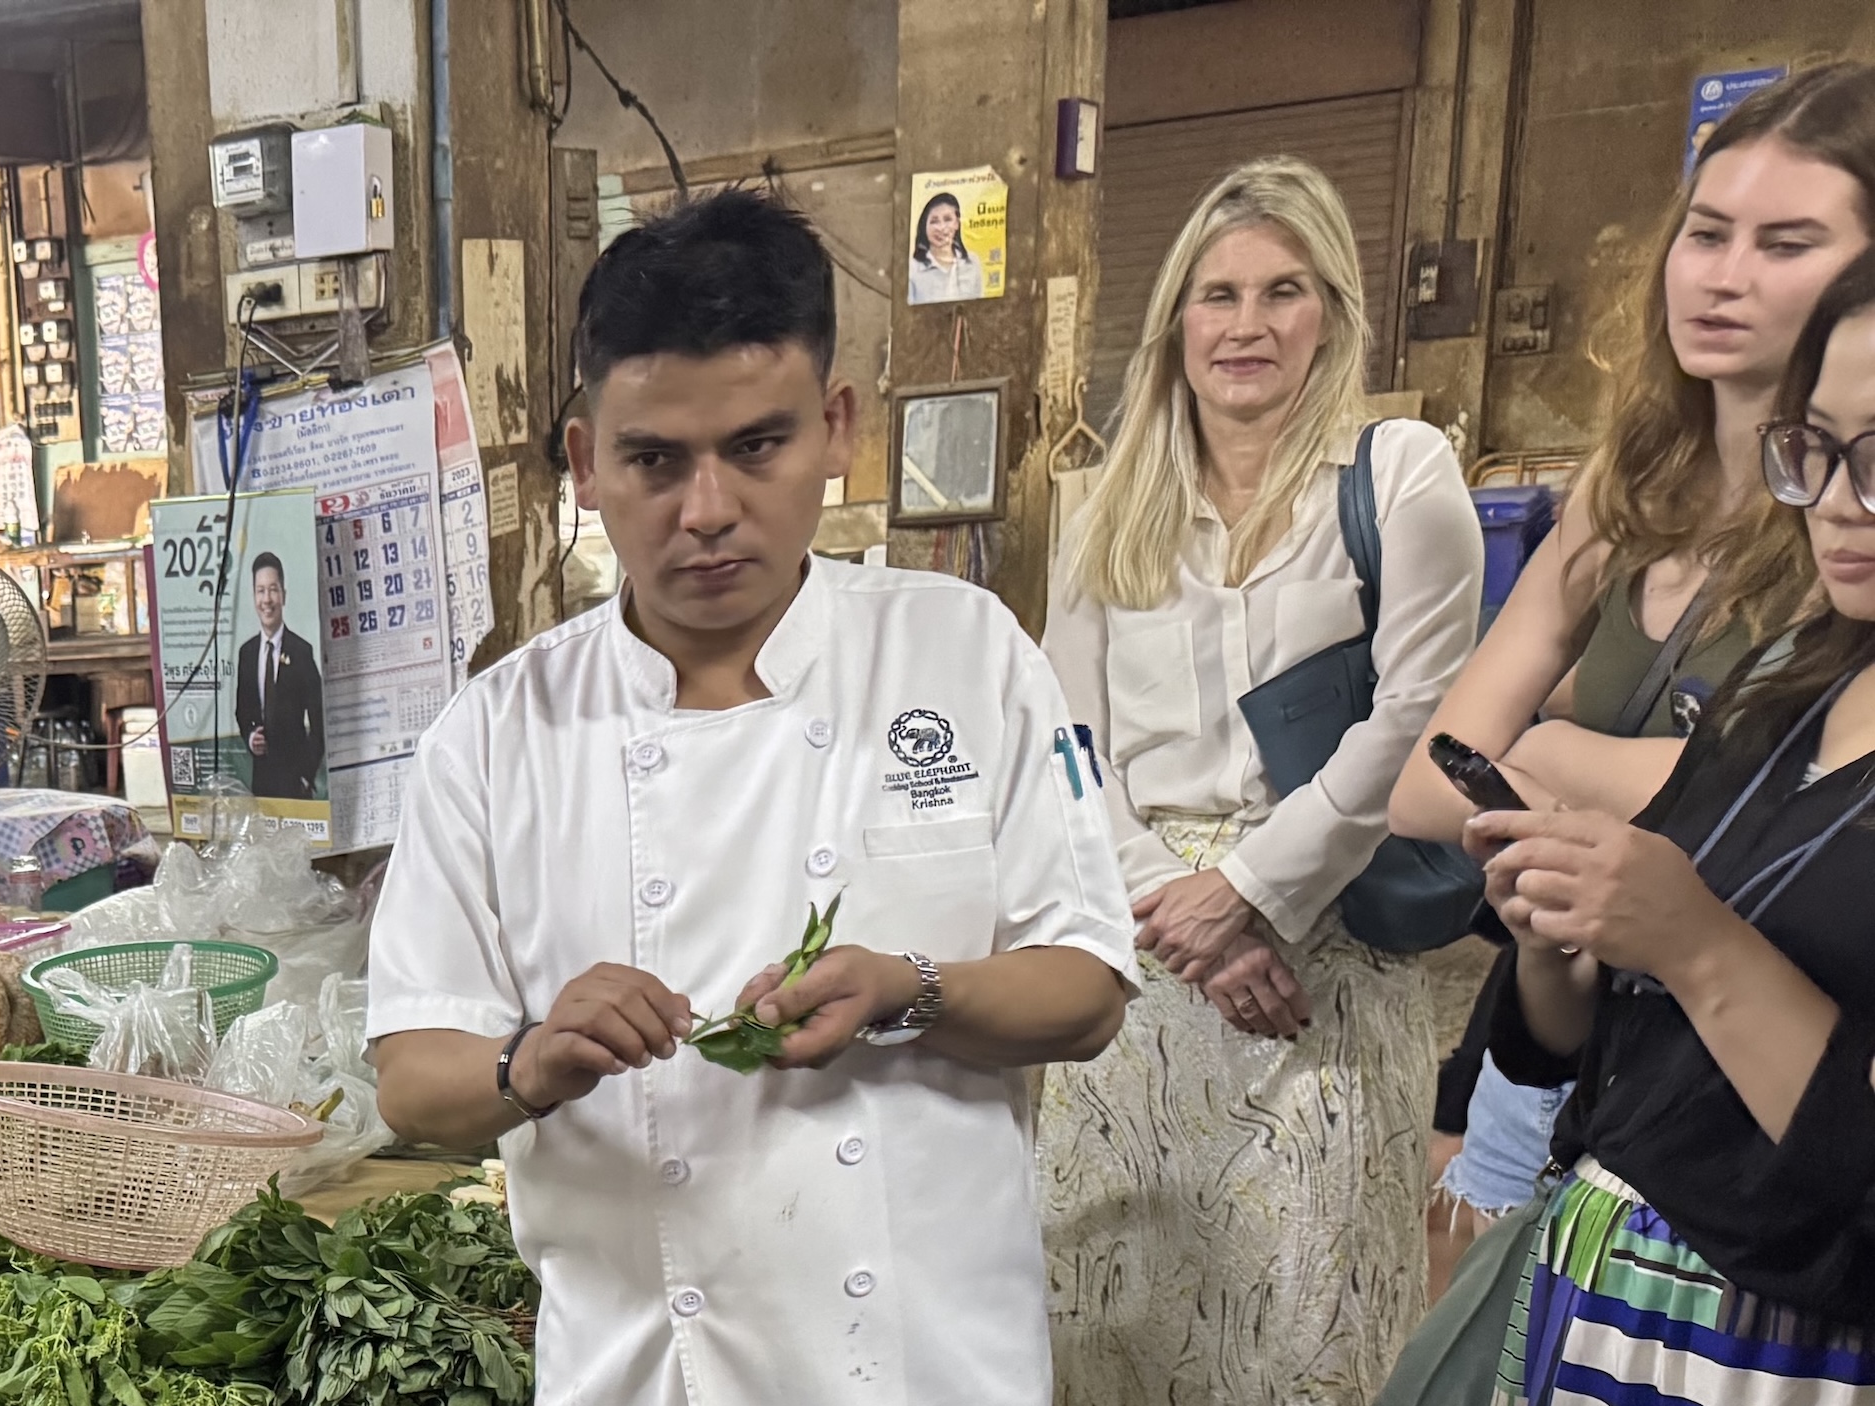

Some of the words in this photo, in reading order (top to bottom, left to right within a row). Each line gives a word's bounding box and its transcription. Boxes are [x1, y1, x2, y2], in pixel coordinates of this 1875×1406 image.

[326, 524, 335, 545] 4
[353, 519, 364, 540] 5
[381, 512, 392, 533] 6
[410, 506, 420, 527] 7
[325, 554, 342, 577] 11
[354, 548, 370, 570] 12
[381, 542, 399, 565] 13
[410, 535, 428, 559] 14
[329, 585, 345, 608] 18
[356, 579, 373, 601] 19
[384, 573, 404, 596] 20
[331, 615, 351, 638] 25
[359, 610, 378, 633] 26
[387, 604, 405, 627] 27
[414, 598, 435, 622] 28
[914, 763, 971, 779] ELEPHANT
[910, 785, 952, 799] Bangkok
[911, 797, 954, 810] Krishna
